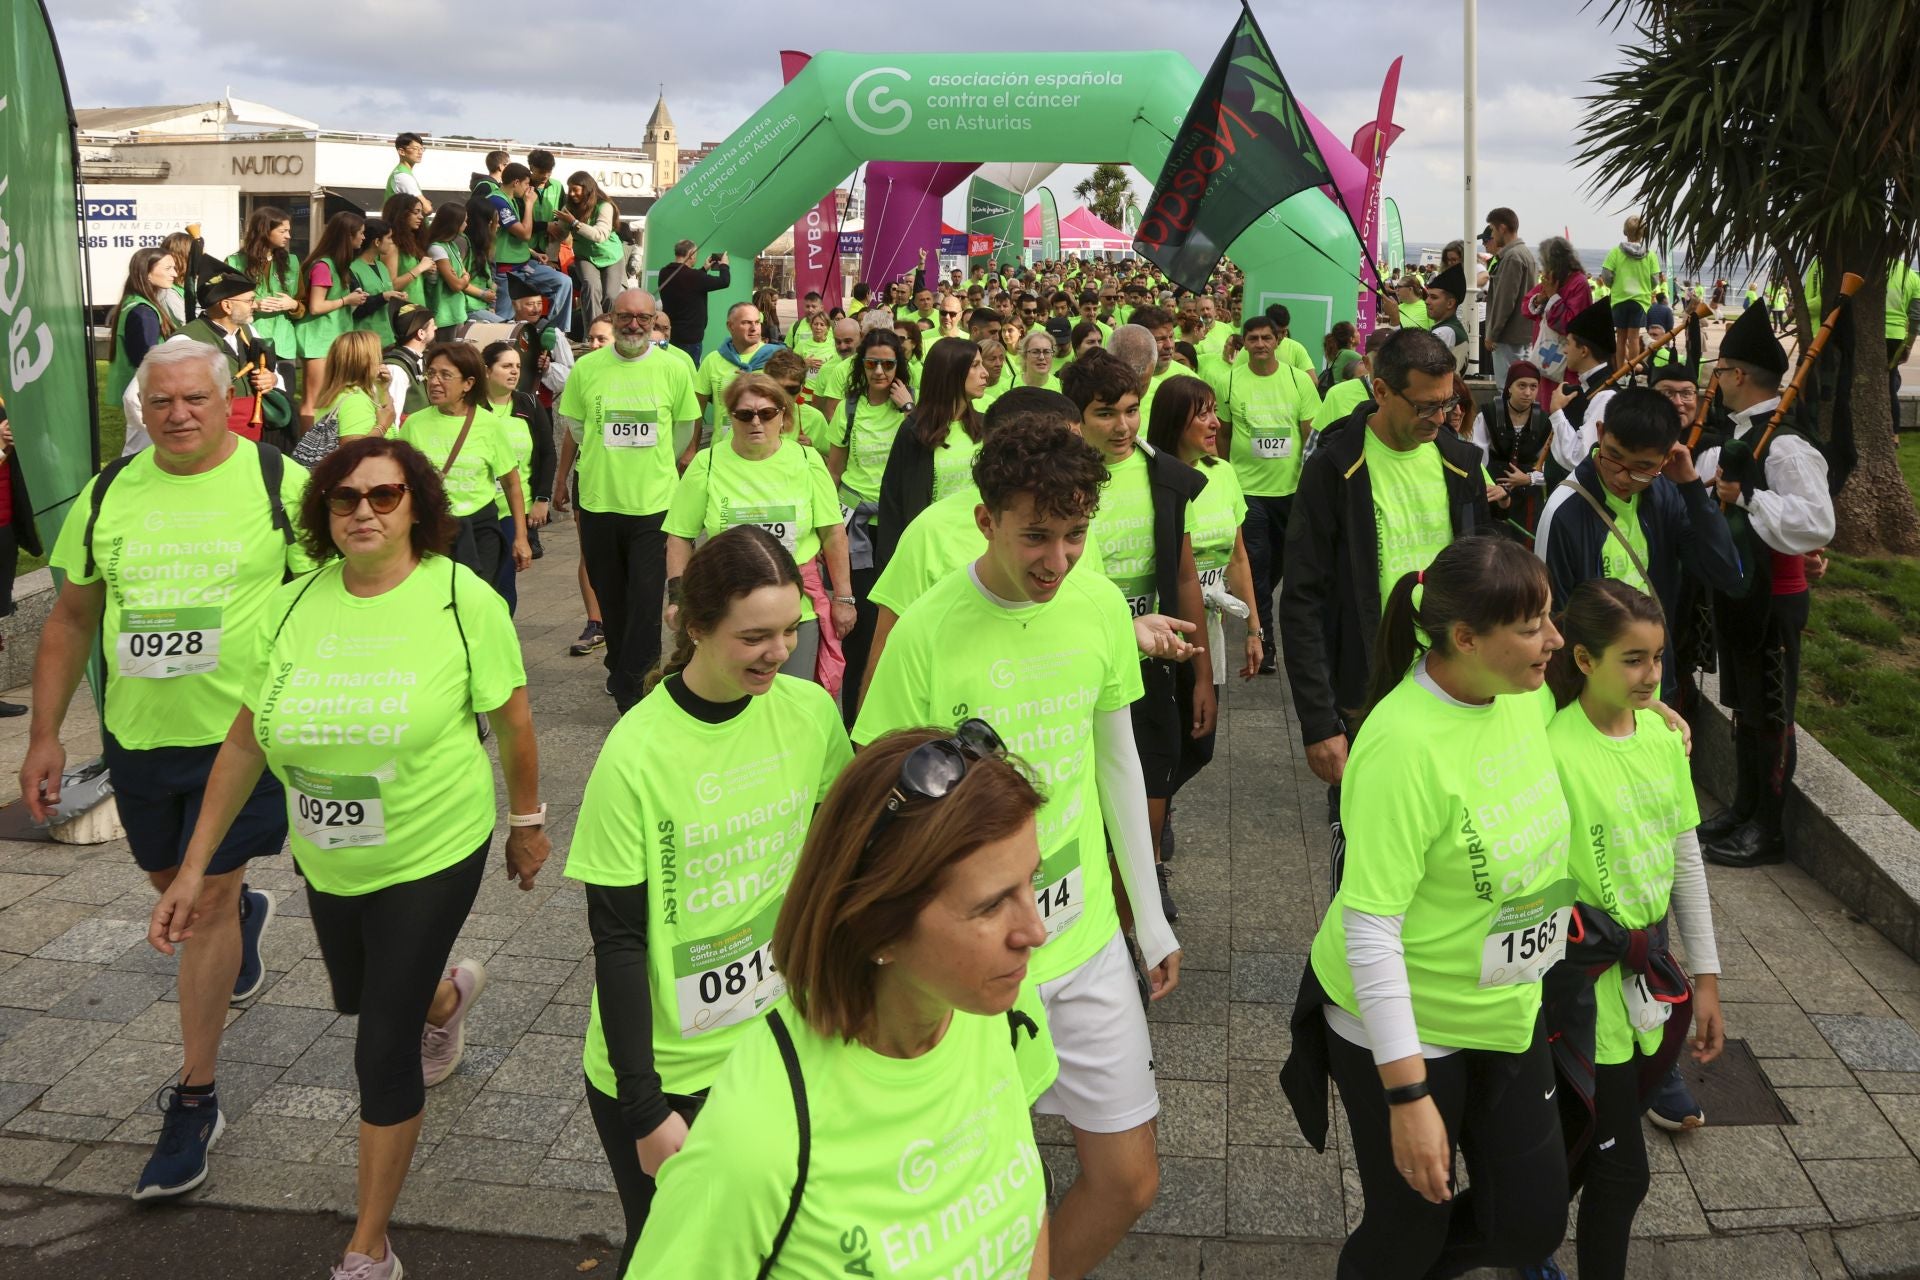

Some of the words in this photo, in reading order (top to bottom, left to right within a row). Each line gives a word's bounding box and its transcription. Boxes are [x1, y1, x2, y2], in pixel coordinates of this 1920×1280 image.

[928, 72, 1029, 86] asociación
[1034, 70, 1123, 89] española
[927, 92, 990, 108] contra
[993, 91, 1010, 108] el
[1014, 91, 1081, 108] cáncer
[927, 117, 950, 131] en
[955, 114, 1032, 131] Asturias
[683, 181, 698, 196] En
[698, 148, 738, 182] marcha
[738, 117, 772, 149] contra
[691, 193, 704, 207] el
[703, 164, 738, 197] cáncer
[738, 151, 753, 166] en
[752, 113, 797, 153] Asturias
[113, 235, 134, 248] 115
[612, 423, 649, 436] 0510
[1257, 438, 1286, 449] 1027
[126, 541, 153, 558] En
[158, 537, 243, 557] marcha
[122, 560, 209, 581] contra
[213, 557, 238, 579] el
[122, 581, 238, 608] cáncer
[130, 631, 203, 658] 0928
[291, 669, 320, 687] En
[325, 667, 417, 687] marcha
[259, 661, 294, 749] ASTURIAS
[279, 693, 375, 715] contra
[379, 692, 410, 715] el
[1016, 684, 1100, 721] marcha
[275, 717, 411, 746] cáncer
[1003, 720, 1077, 754] ontra
[299, 793, 365, 827] 0929
[1477, 803, 1510, 831] En
[683, 821, 719, 848] En
[684, 830, 786, 879] contra
[657, 819, 678, 926] ASTURIAS
[1590, 823, 1620, 916] ASTURIAS
[690, 943, 711, 954] Gijón
[1501, 911, 1558, 964] 1565
[690, 950, 718, 962] contra
[699, 940, 778, 1004] 081
[879, 1222, 933, 1274] En
